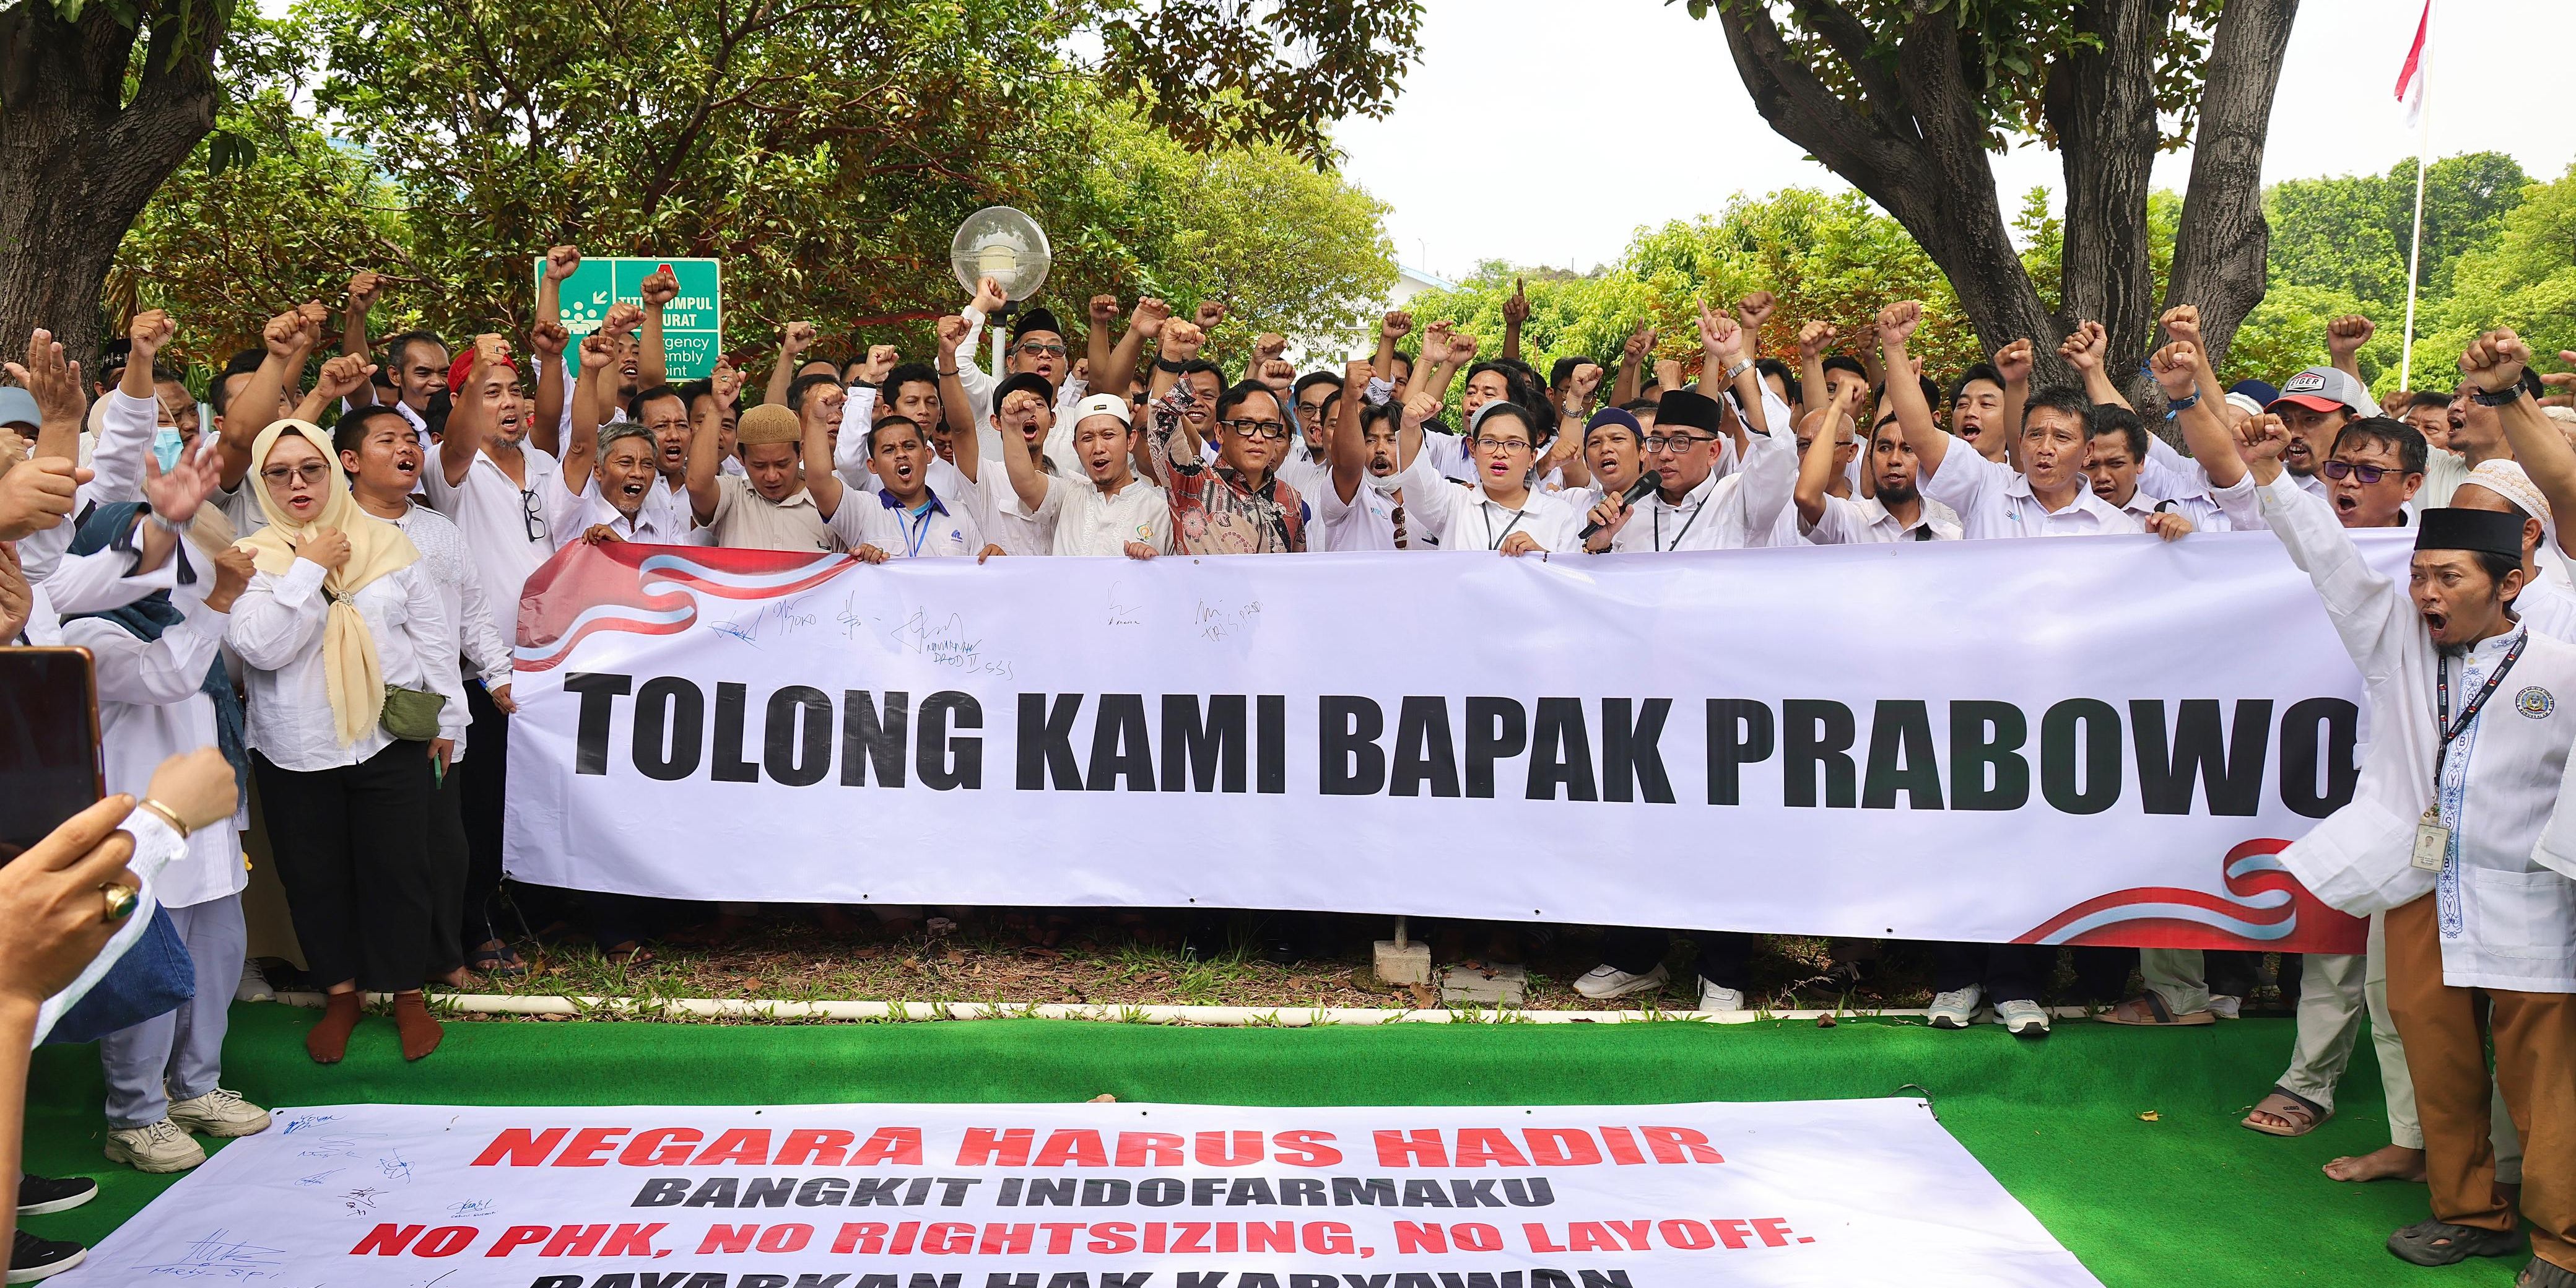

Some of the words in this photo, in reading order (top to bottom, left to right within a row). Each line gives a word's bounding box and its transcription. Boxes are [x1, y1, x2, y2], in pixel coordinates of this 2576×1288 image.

[618, 297, 643, 310] TITI
[663, 297, 713, 310] UMPUL
[662, 313, 697, 327] URAT
[2291, 378, 2319, 386] EIGER
[2492, 666, 2504, 681] BAWASLU
[2472, 692, 2484, 707] BAWASLU
[2450, 719, 2463, 733] BAWASLU
[563, 672, 983, 791] TOLONG
[1016, 693, 1286, 794] KAMI
[1319, 695, 1677, 804] BAPAK
[1706, 697, 2361, 819] PRABOWO
[2459, 736, 2466, 746] B
[2449, 773, 2457, 788] Y
[2445, 816, 2452, 828] S
[2443, 858, 2450, 868] B
[2445, 900, 2453, 915] Y
[471, 1127, 923, 1167] NEGARA
[955, 1127, 1343, 1168] HARUS
[1373, 1126, 1725, 1168] HADIR
[630, 1177, 982, 1208] BANGKIT
[996, 1177, 1555, 1208] INDOFARMAKU
[349, 1222, 479, 1258] NO
[485, 1222, 672, 1259] PHK,
[695, 1223, 815, 1255] NO
[830, 1221, 1375, 1259] RIGHTSIZING,
[1393, 1220, 1504, 1255] NO
[1522, 1217, 1815, 1253] LAYOFF.
